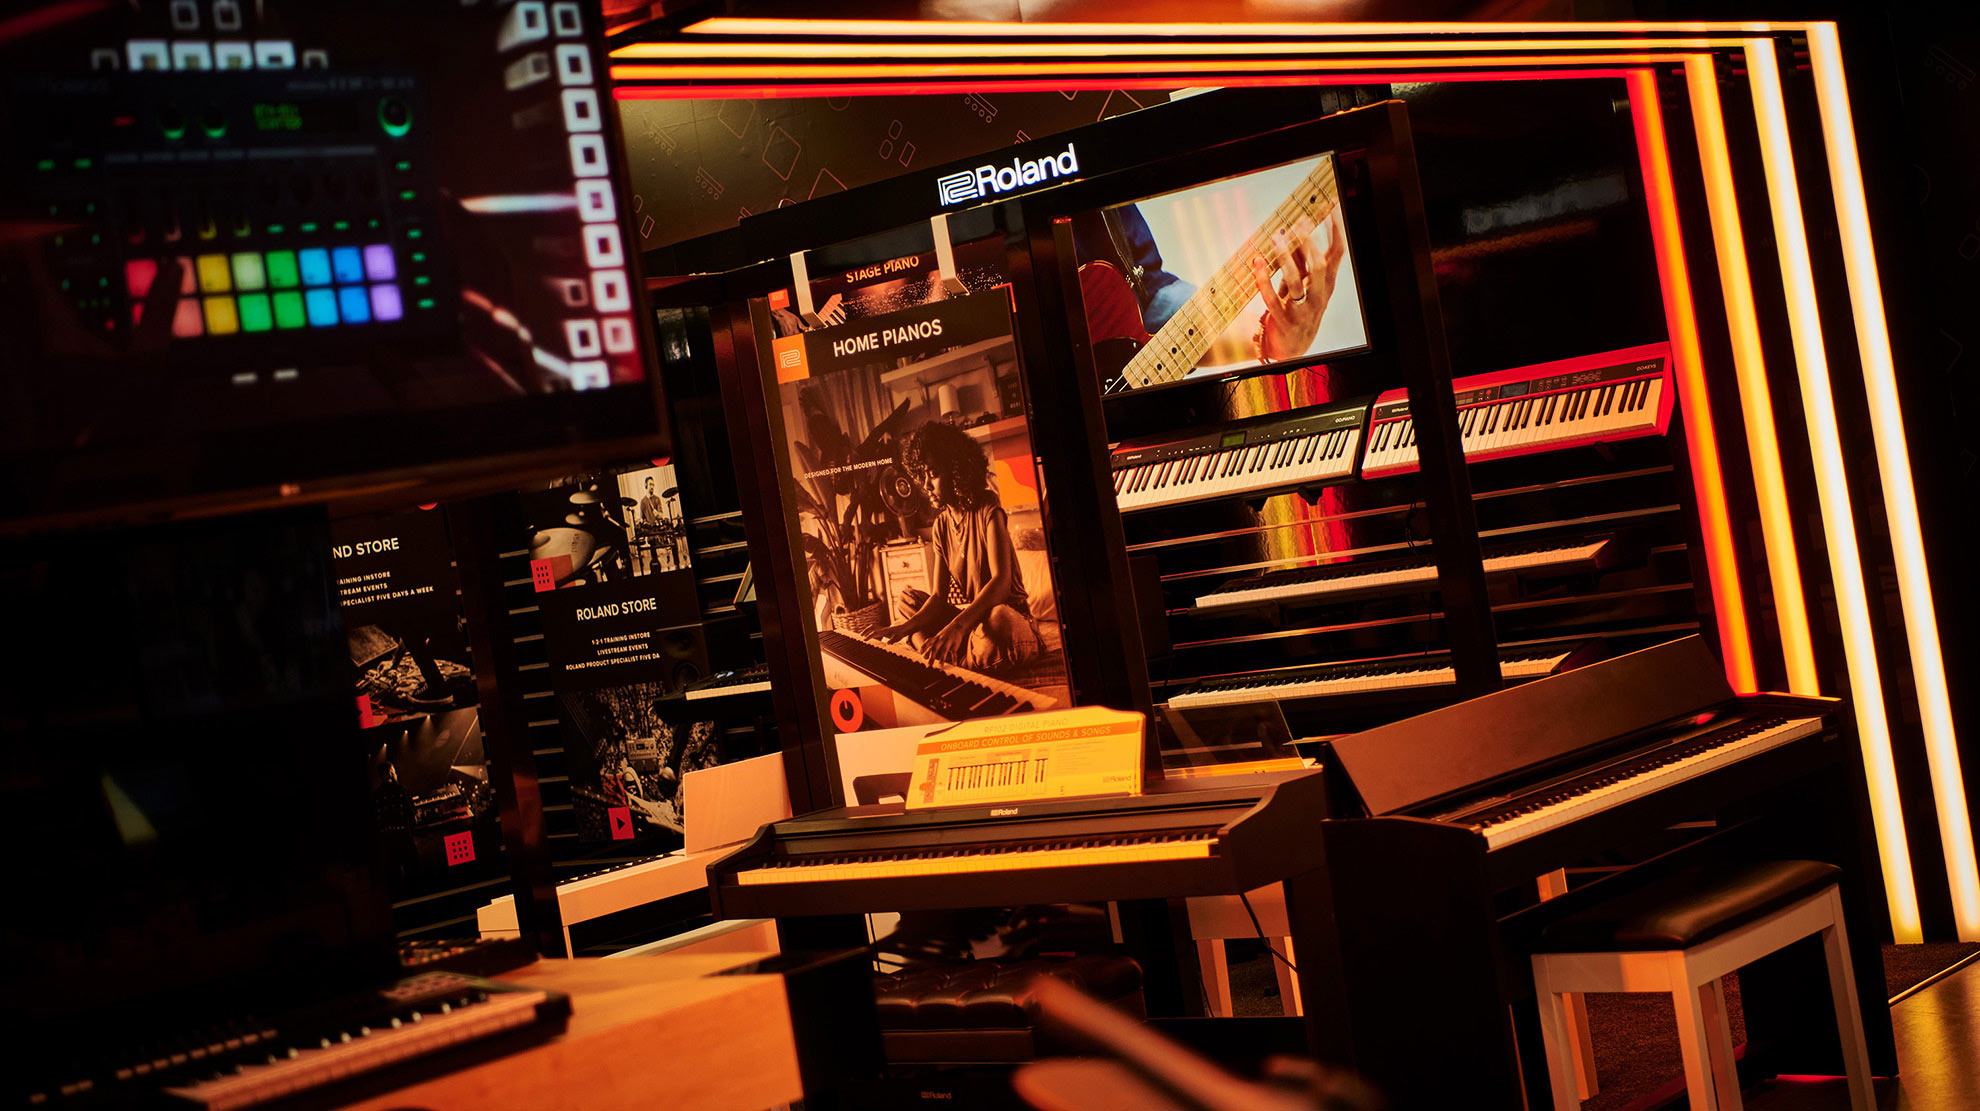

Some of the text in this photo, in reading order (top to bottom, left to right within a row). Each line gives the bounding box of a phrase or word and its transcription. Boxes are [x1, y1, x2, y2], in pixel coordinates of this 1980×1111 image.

[975, 142, 1079, 197] Roland
[846, 256, 920, 283] STAGE PIANO
[833, 318, 943, 358] HOME PIANOS
[803, 457, 893, 479] DESIGNED FOR THE MODERN HOME
[355, 537, 400, 556] STORE
[337, 571, 391, 585] AINING INSTORE
[338, 582, 388, 596] TREAM EVENTS
[376, 592, 391, 601] FIVE
[392, 589, 409, 599] DAYS
[410, 588, 416, 596] A
[416, 585, 434, 595] WEEK
[576, 597, 657, 621] ROLAND STORE
[604, 634, 628, 644] TRAINING
[628, 631, 651, 641] INSTORE
[596, 643, 649, 656] LIVESTREAM EVENTS
[565, 662, 586, 671] ROLAND
[586, 658, 610, 668] PRODUCT
[610, 655, 638, 665] SPECIALIST
[639, 653, 651, 661] FIVE
[1042, 717, 1069, 728] PIANO
[940, 726, 1112, 752] ONBOARD CONTROL OF SOUNDS & SONGS
